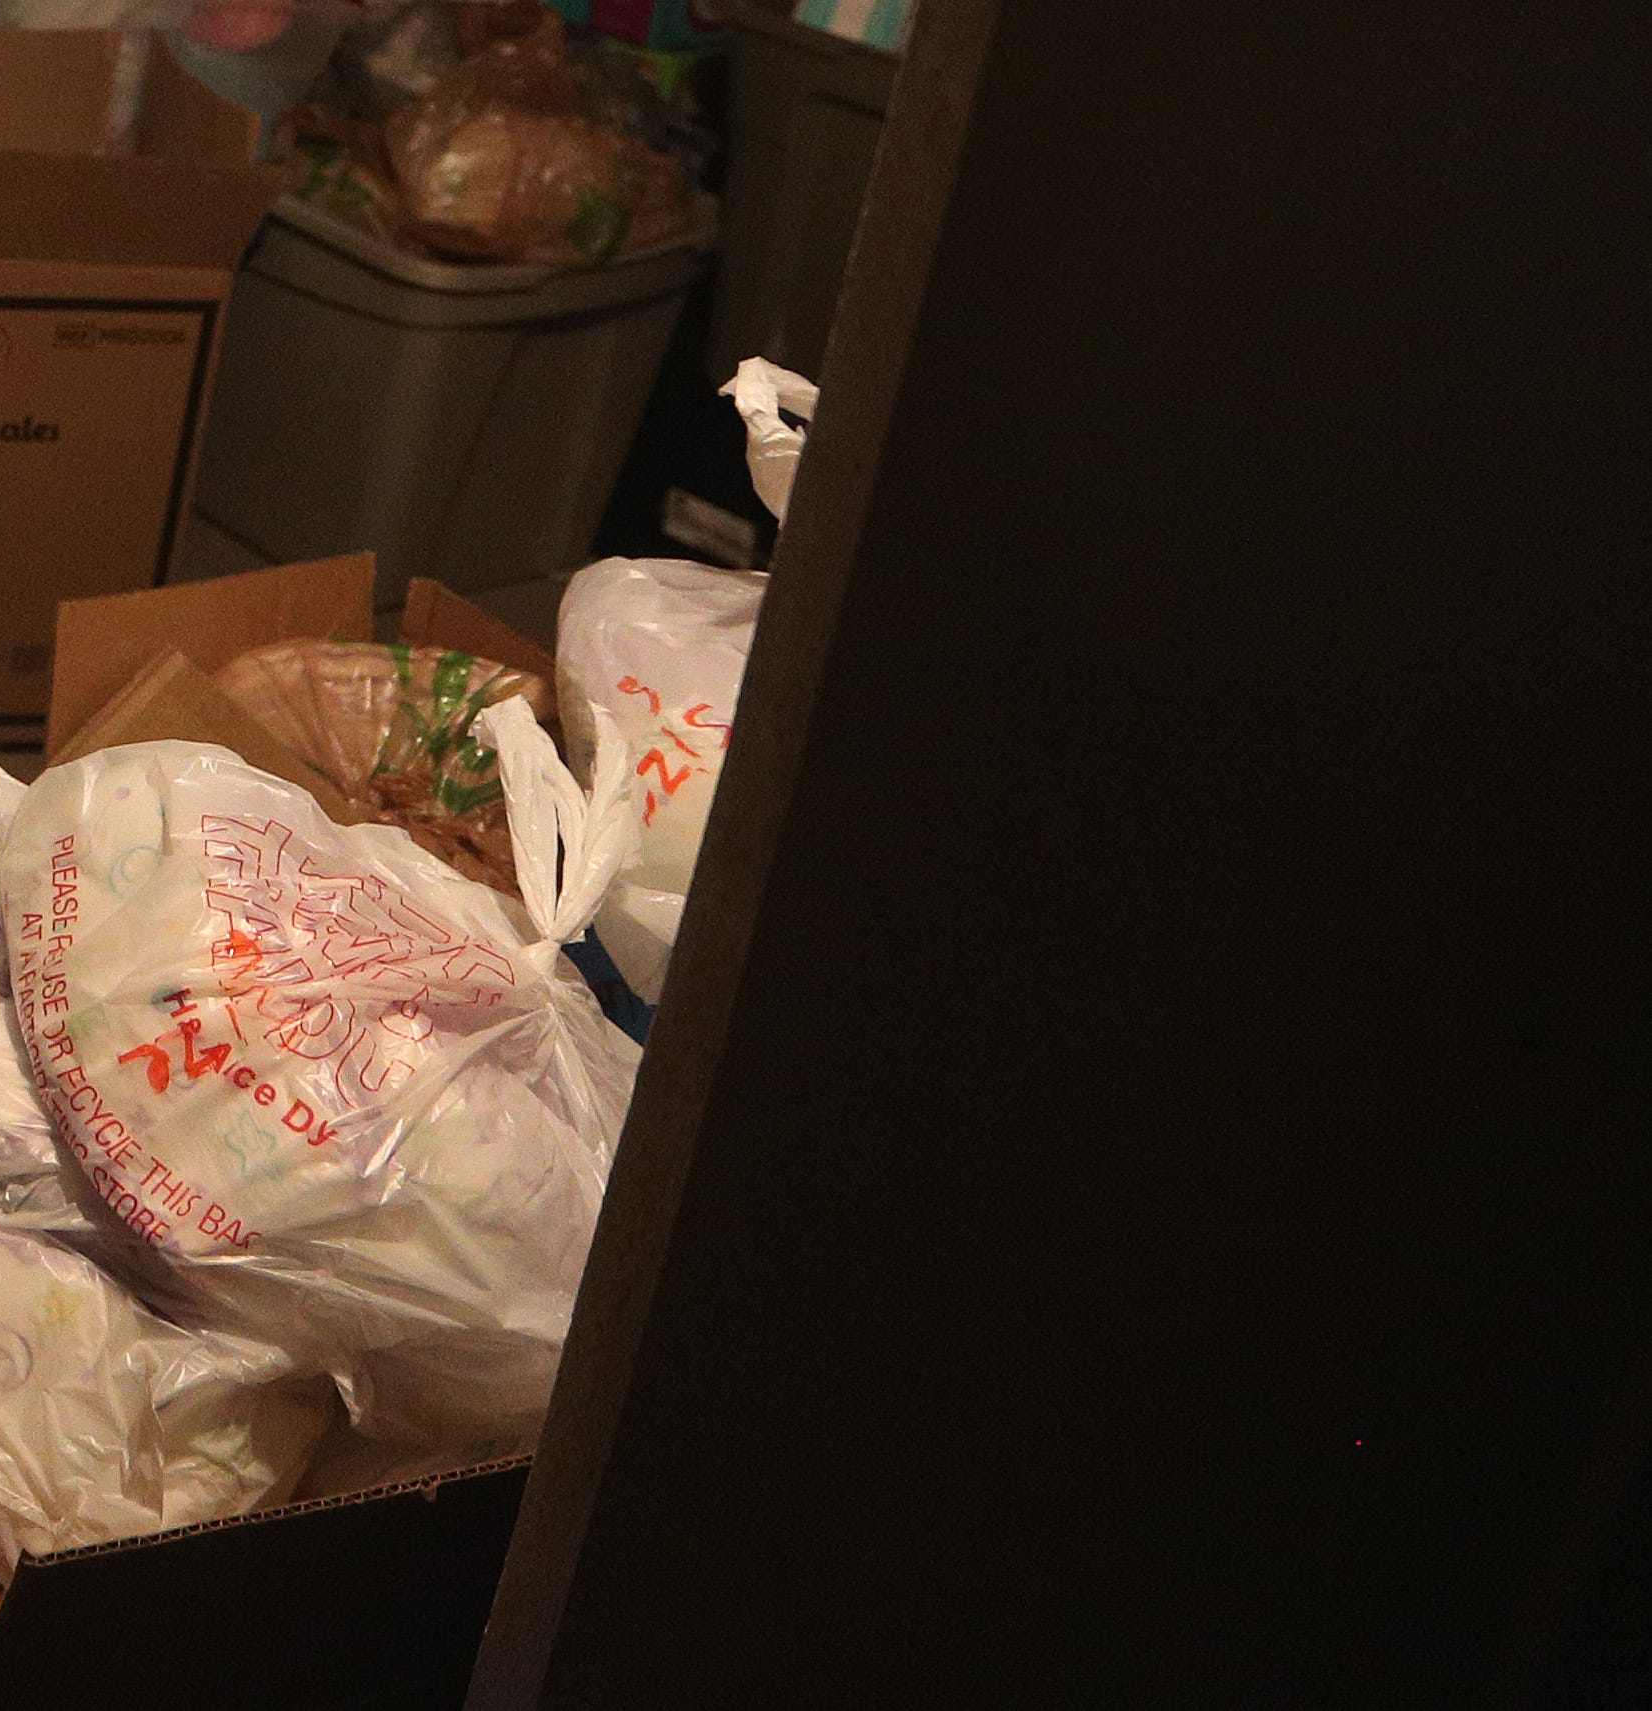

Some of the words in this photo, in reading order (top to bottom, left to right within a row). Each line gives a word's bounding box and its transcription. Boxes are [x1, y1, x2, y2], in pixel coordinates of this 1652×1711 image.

[51, 834, 79, 933] PLEASE
[22, 913, 43, 940] AT
[57, 1065, 143, 1171] ECYCLE
[139, 1156, 203, 1217] THIS
